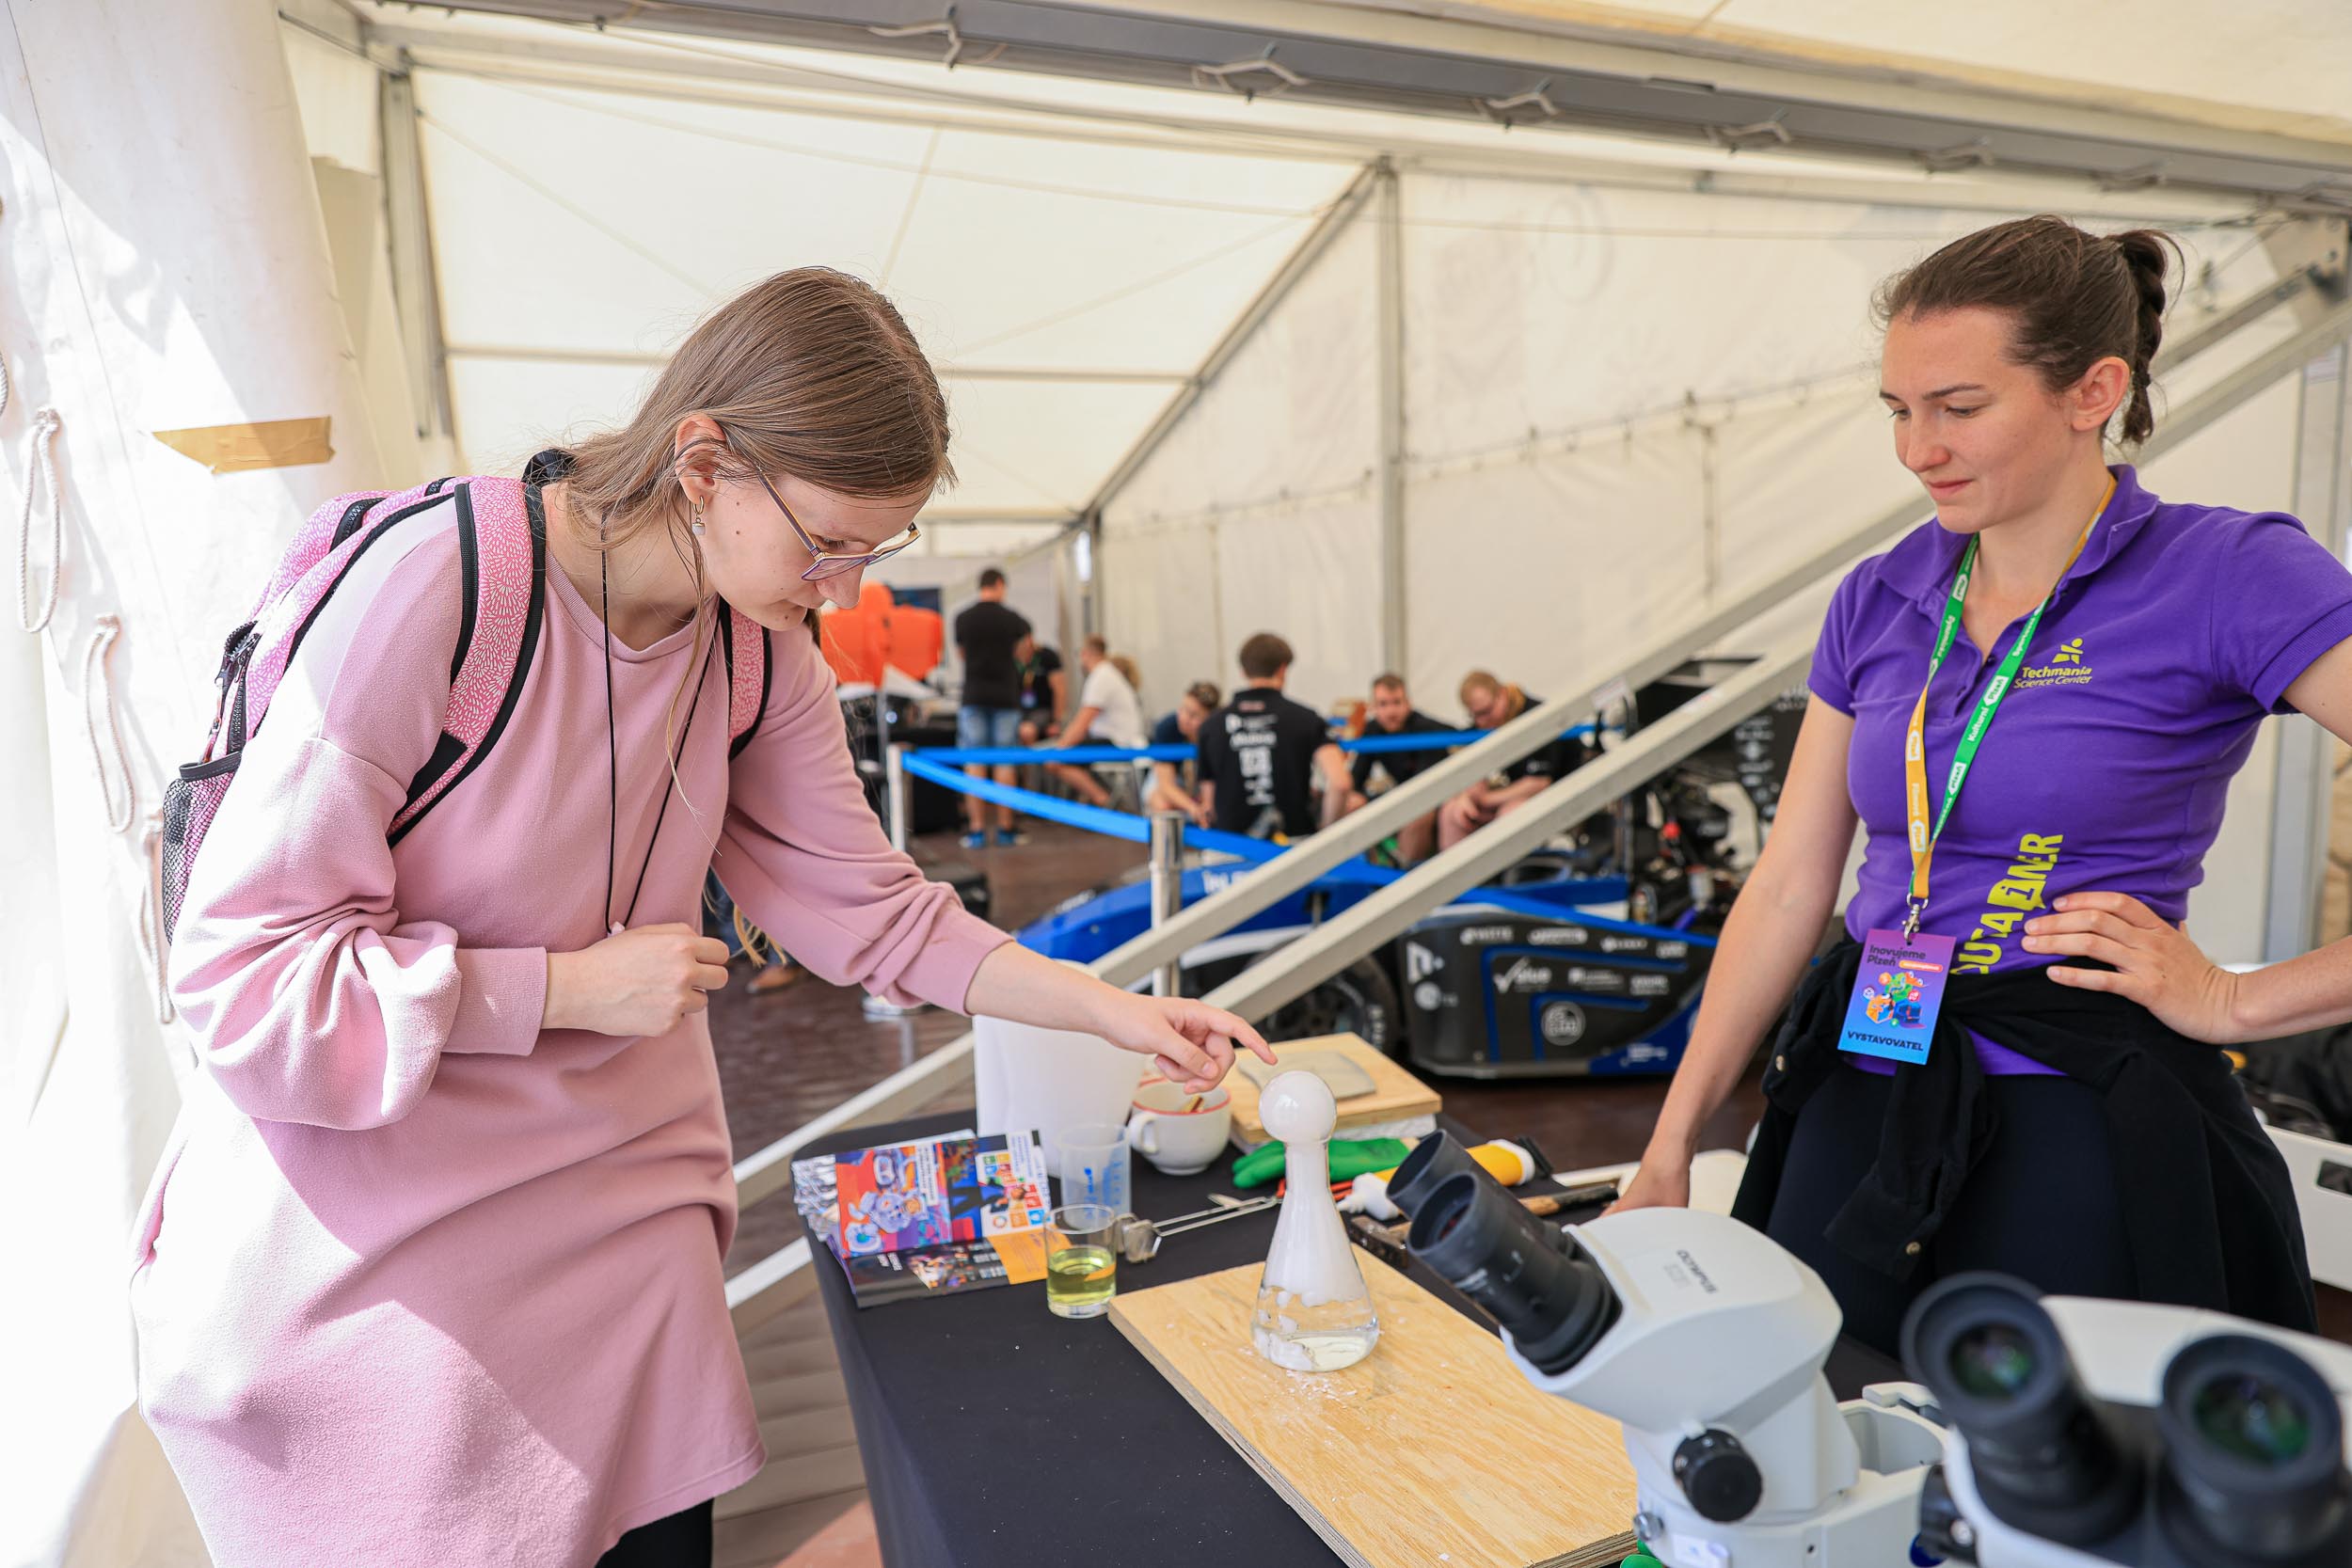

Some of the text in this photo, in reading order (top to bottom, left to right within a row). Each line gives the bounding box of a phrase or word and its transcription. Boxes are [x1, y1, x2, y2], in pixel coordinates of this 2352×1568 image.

[2022, 666, 2092, 678] Techmania
[2014, 675, 2092, 689] Science Center
[1869, 944, 1927, 959] Inovujeme
[1867, 955, 1896, 966] Plzeň
[1847, 1031, 1924, 1052] VYSTAVOVATEL
